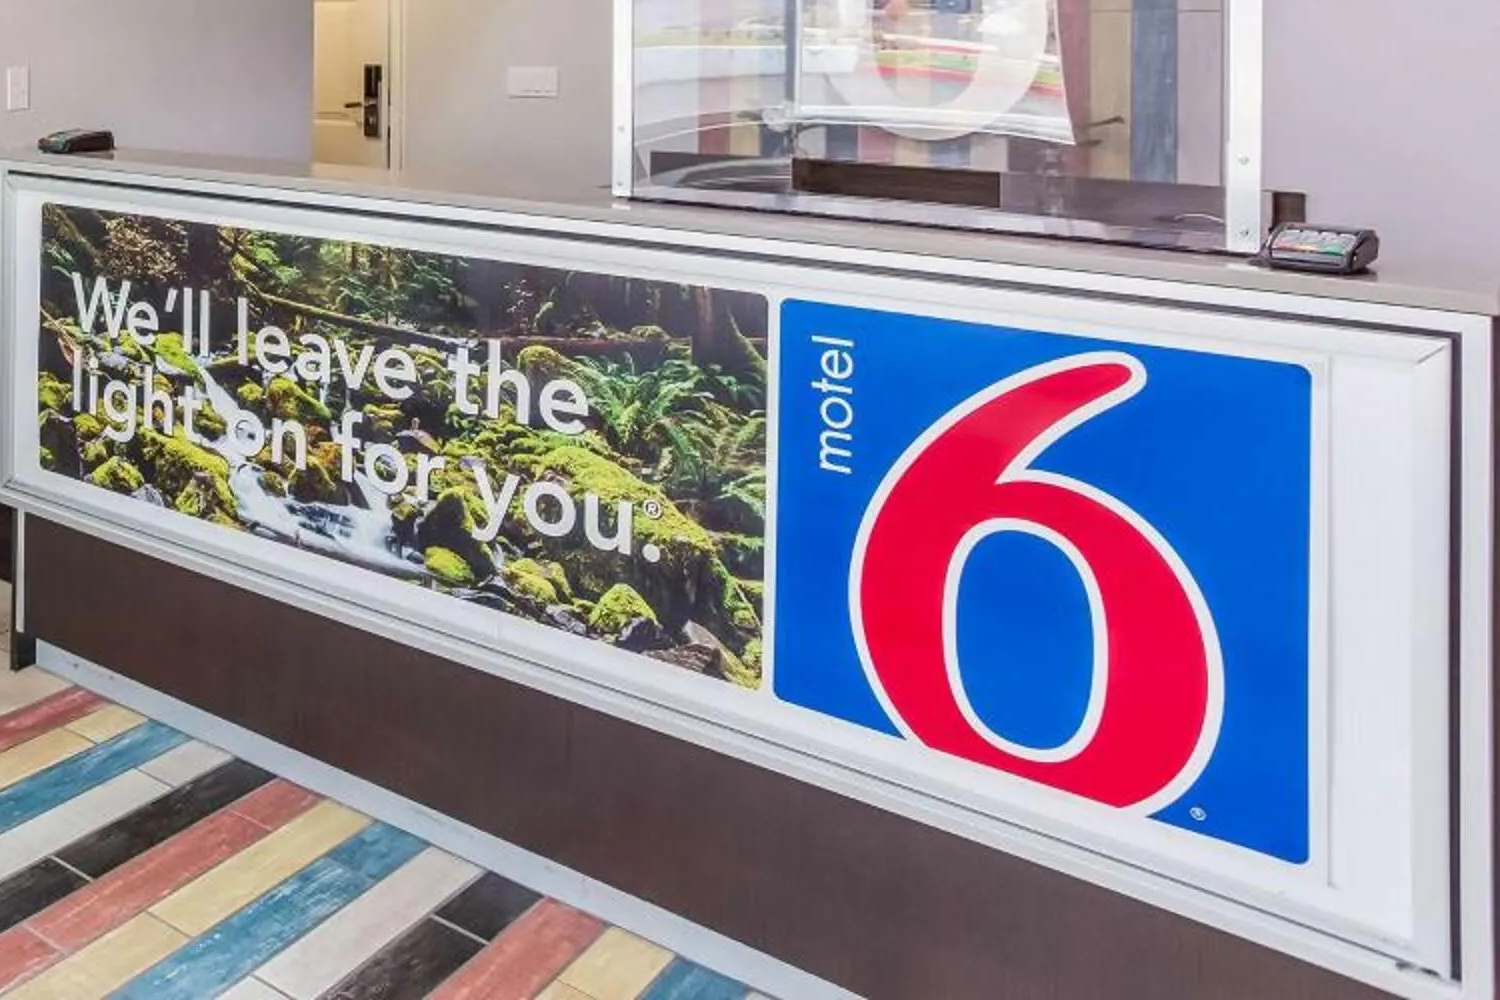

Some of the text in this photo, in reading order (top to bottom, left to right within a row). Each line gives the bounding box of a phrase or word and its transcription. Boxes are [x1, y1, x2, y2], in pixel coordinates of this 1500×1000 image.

[72, 347, 205, 445] light
[225, 409, 308, 470] on
[333, 409, 446, 504] for
[237, 296, 418, 401] leave
[447, 339, 591, 436] the
[810, 334, 855, 476] motel
[848, 350, 1226, 819] 6
